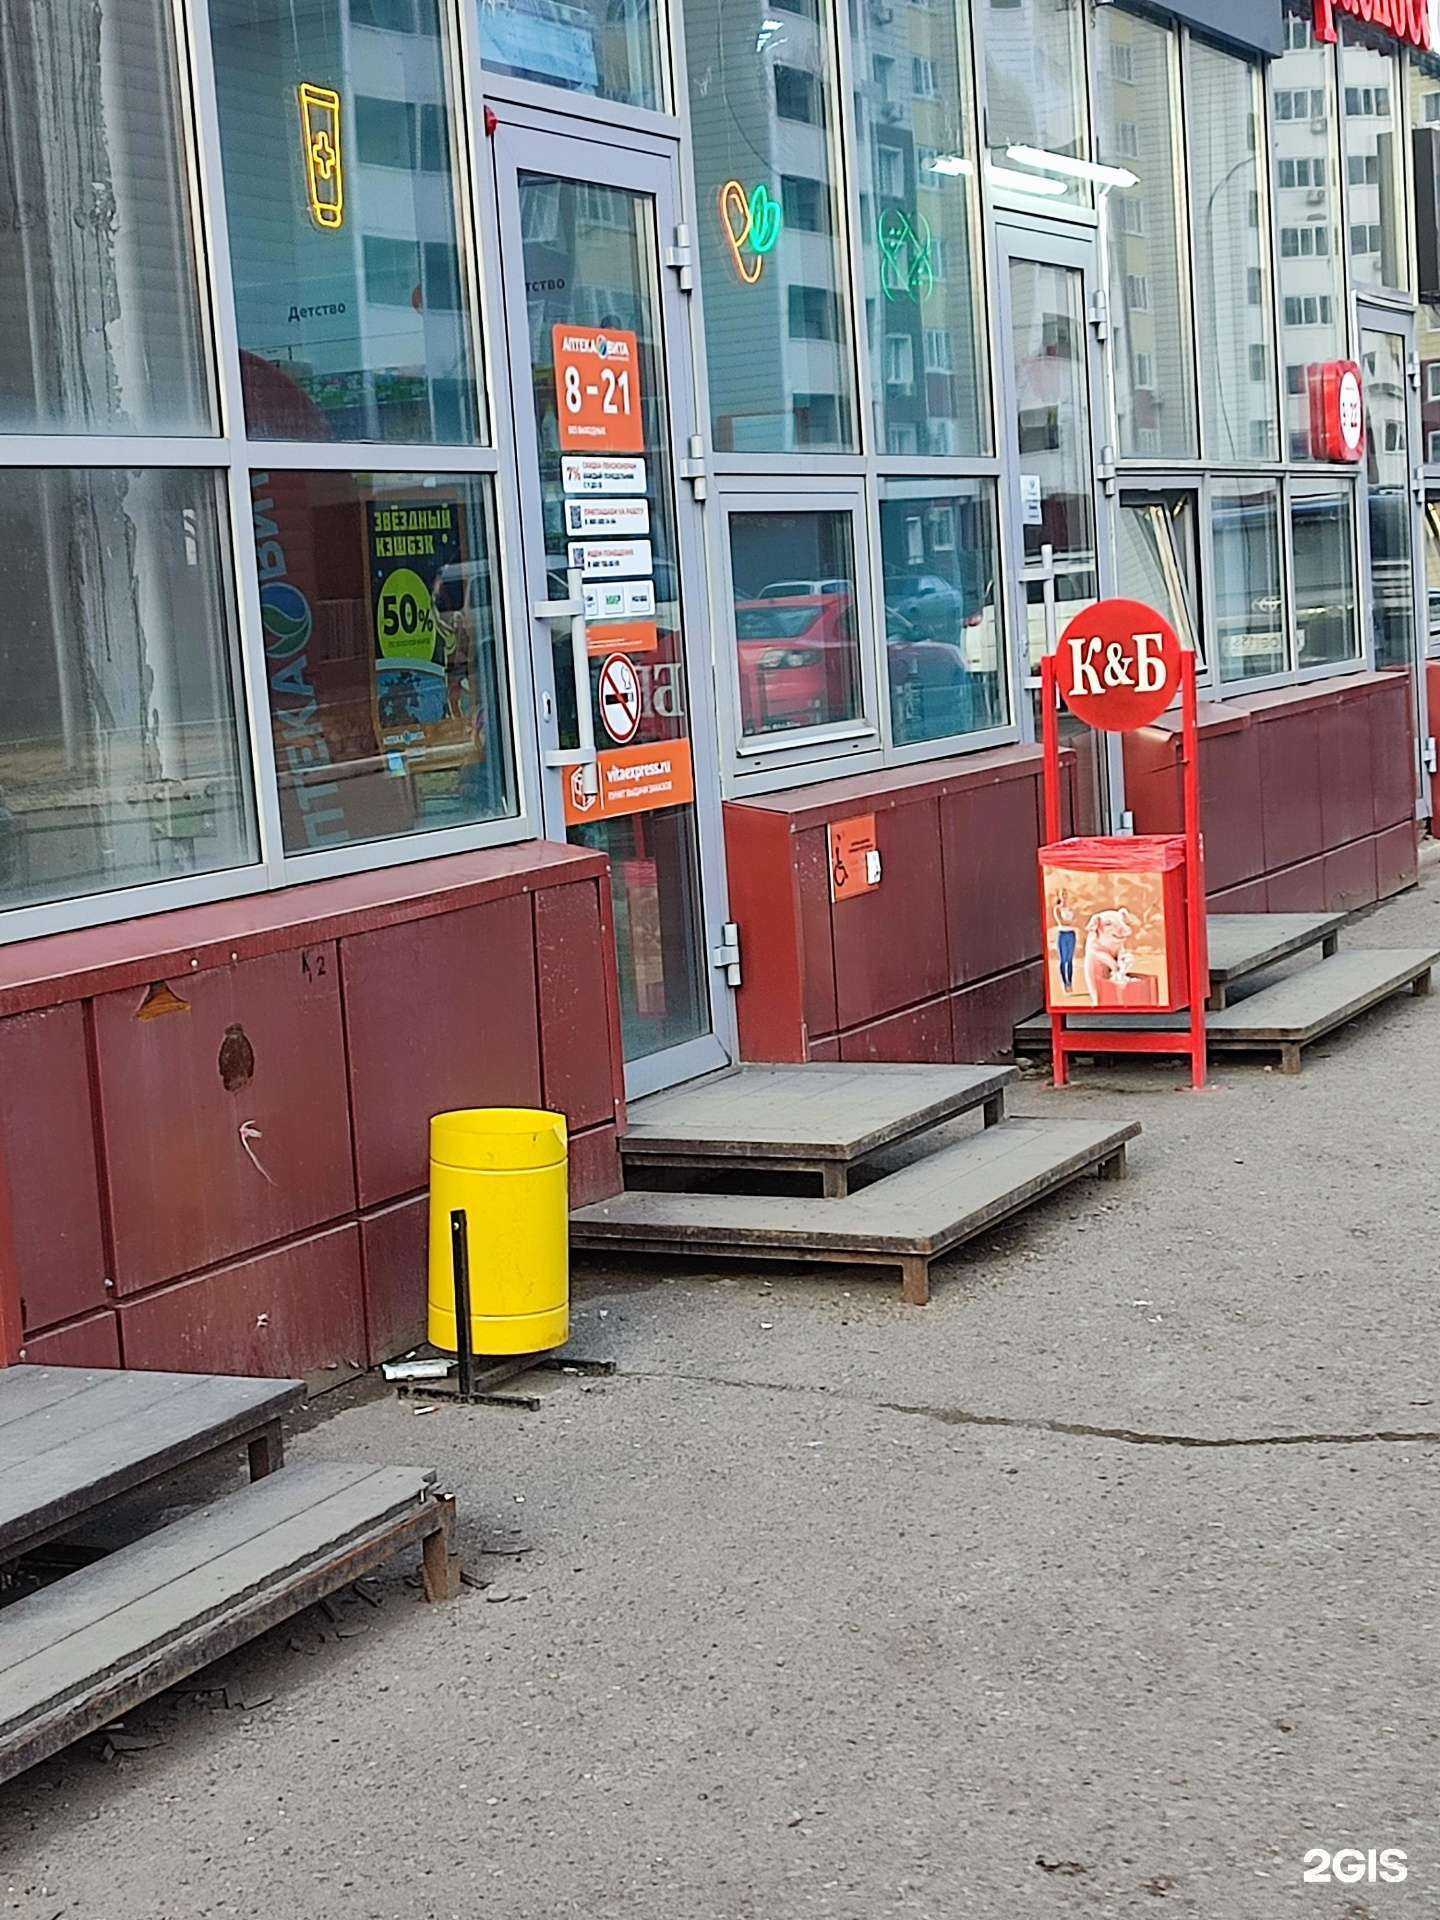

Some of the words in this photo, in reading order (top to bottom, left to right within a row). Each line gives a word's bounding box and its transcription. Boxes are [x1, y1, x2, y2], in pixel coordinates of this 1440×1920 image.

[288, 303, 346, 323] Детство
[374, 503, 452, 532] ЗВЁЗДНЫЙ
[375, 535, 435, 557] КЭШБЭК
[382, 593, 434, 637] 50%
[1067, 632, 1168, 696] К&Б
